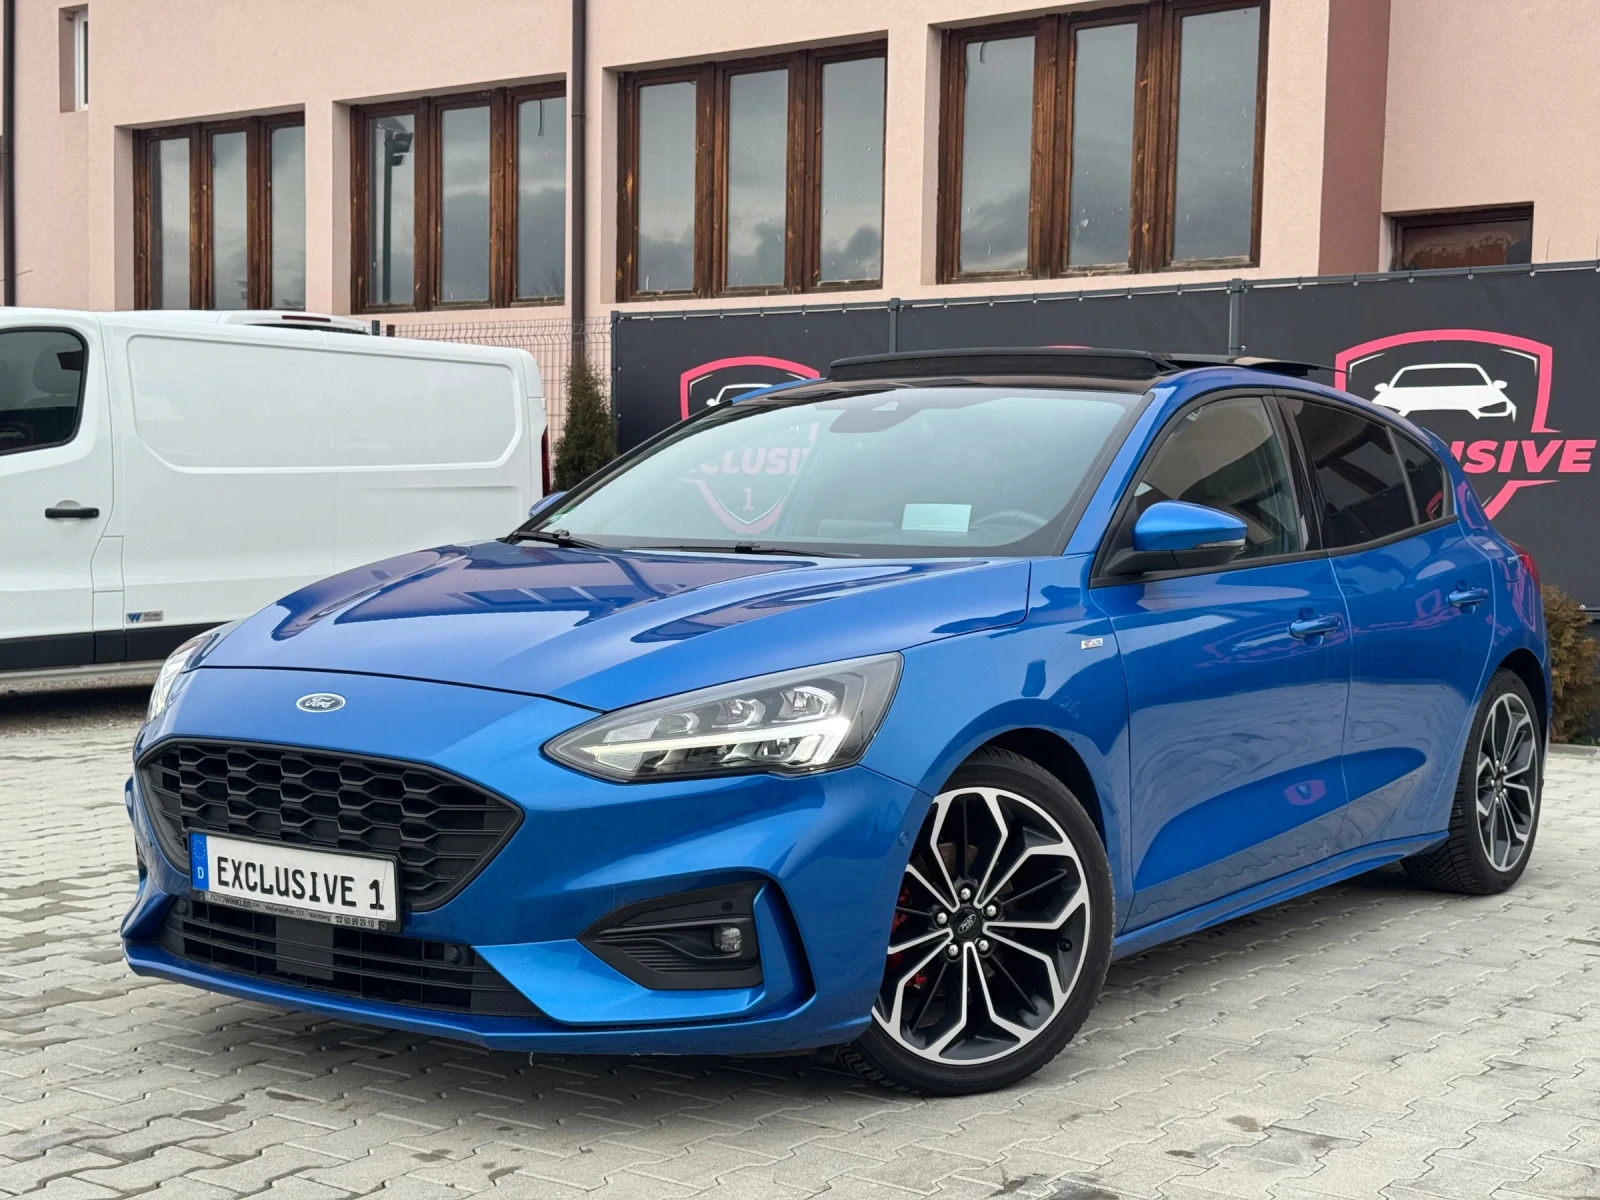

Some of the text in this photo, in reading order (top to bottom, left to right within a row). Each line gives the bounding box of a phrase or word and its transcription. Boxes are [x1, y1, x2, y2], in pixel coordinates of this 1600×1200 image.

[1450, 439, 1597, 474] SIVE
[742, 487, 755, 510] 1
[197, 866, 205, 880] D
[217, 856, 385, 911] EXCLUSIVE 1
